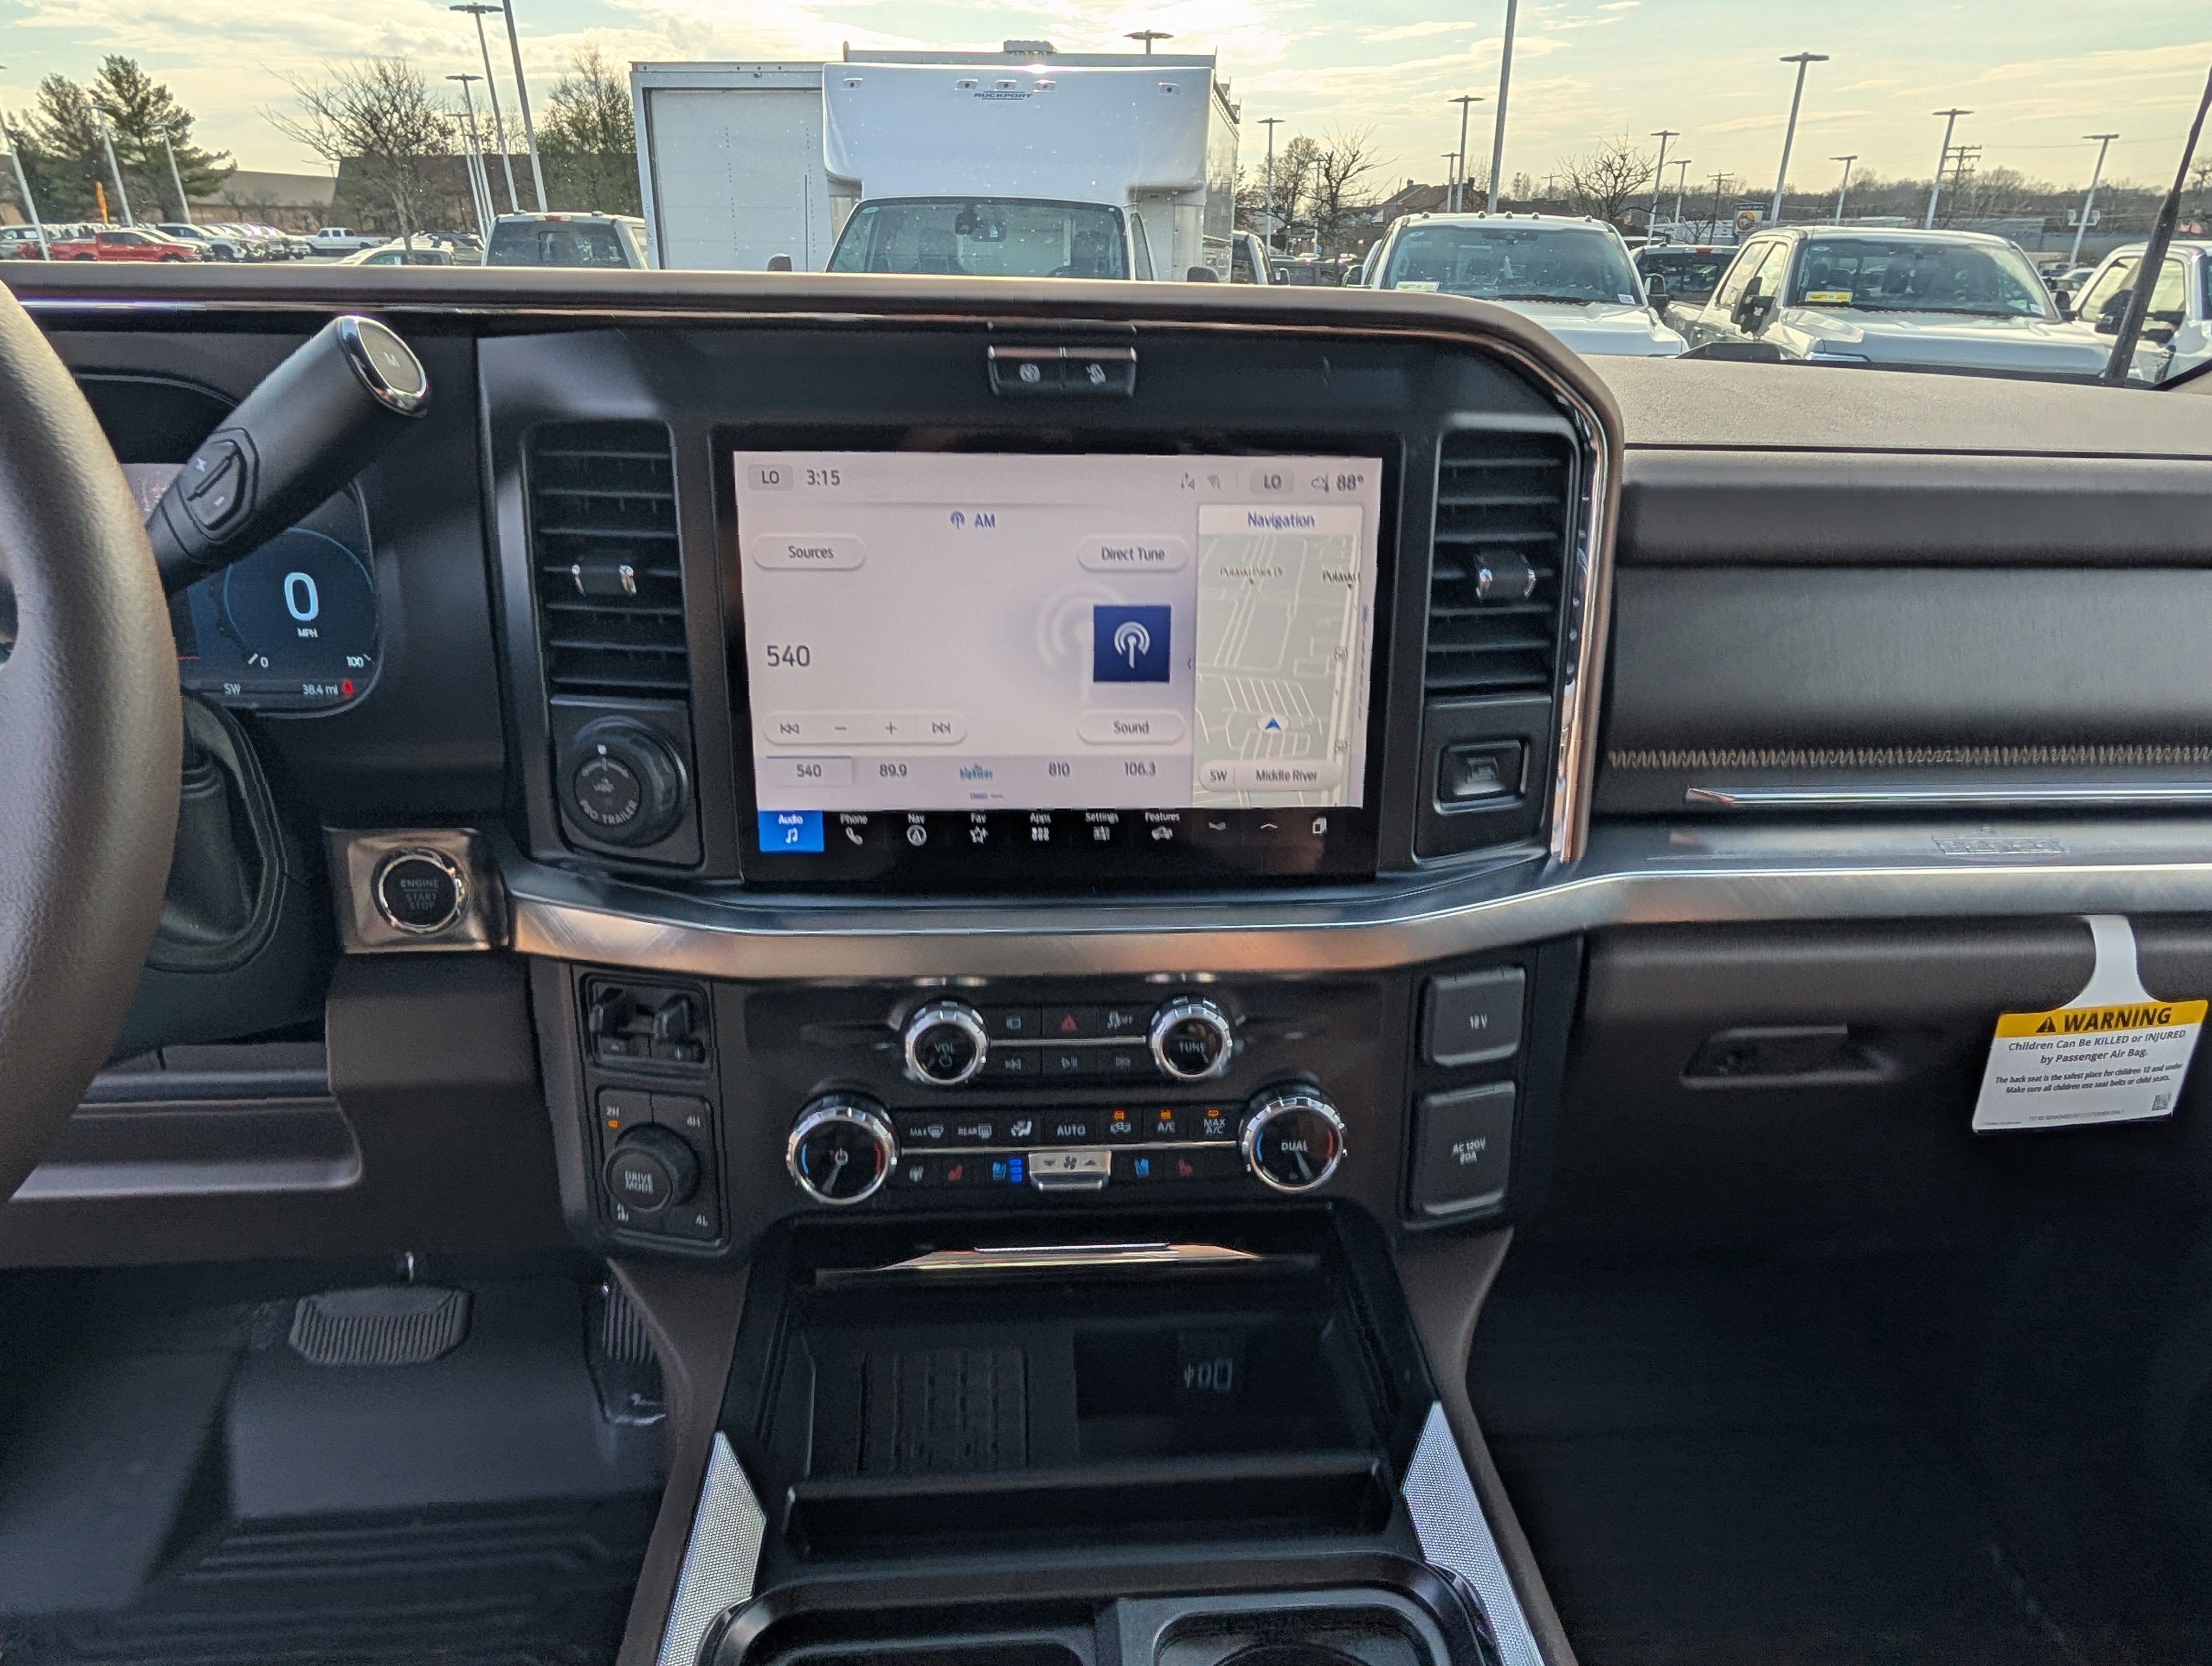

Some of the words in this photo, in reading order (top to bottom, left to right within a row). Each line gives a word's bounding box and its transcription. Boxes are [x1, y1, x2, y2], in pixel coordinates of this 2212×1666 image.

[761, 470, 780, 484] LO
[807, 470, 840, 486] 3:15
[1264, 474, 1282, 488] LO
[974, 514, 996, 529] AM
[1247, 512, 1315, 529] Navigation
[788, 545, 834, 559] Sources
[1101, 546, 1137, 561] Direct
[1138, 546, 1165, 561] Tune
[284, 572, 319, 621] 0
[298, 628, 318, 638] MPH
[260, 657, 269, 668] 0
[346, 656, 364, 668] 100
[767, 645, 811, 668] 540
[223, 683, 241, 695] SW
[303, 684, 323, 695] 38.4
[1113, 720, 1149, 734] Sound
[796, 764, 822, 778] 540
[879, 764, 908, 778] 89.9
[1048, 762, 1070, 777] 810
[1124, 761, 1156, 776] 106.3
[1256, 768, 1290, 782] Middle
[1292, 768, 1318, 782] River
[1209, 770, 1227, 782] SW
[778, 814, 803, 825] Audio
[1145, 812, 1180, 822] Features
[400, 879, 439, 888] ENGINE
[2065, 1007, 2172, 1032] WARNING
[2009, 1041, 2053, 1051] Children
[2056, 1040, 2075, 1049] Can
[2094, 1035, 2129, 1046] KILLED
[2145, 1030, 2186, 1042] INJURED
[2040, 1055, 2054, 1065] by
[2055, 1052, 2108, 1063] Passenger
[2110, 1049, 2126, 1059] Air
[2127, 1048, 2148, 1058] Bag.
[2085, 1072, 2102, 1080] place
[2115, 1068, 2141, 1076] children
[1157, 1121, 1175, 1133] A/C
[1204, 1118, 1225, 1127] MAX
[958, 1127, 976, 1136] REAR
[1057, 1124, 1086, 1137] AUTO
[1206, 1126, 1224, 1134] A/C
[1281, 1140, 1308, 1152] DUAL
[1453, 1143, 1464, 1154] AC
[1466, 1137, 1486, 1150] 120V
